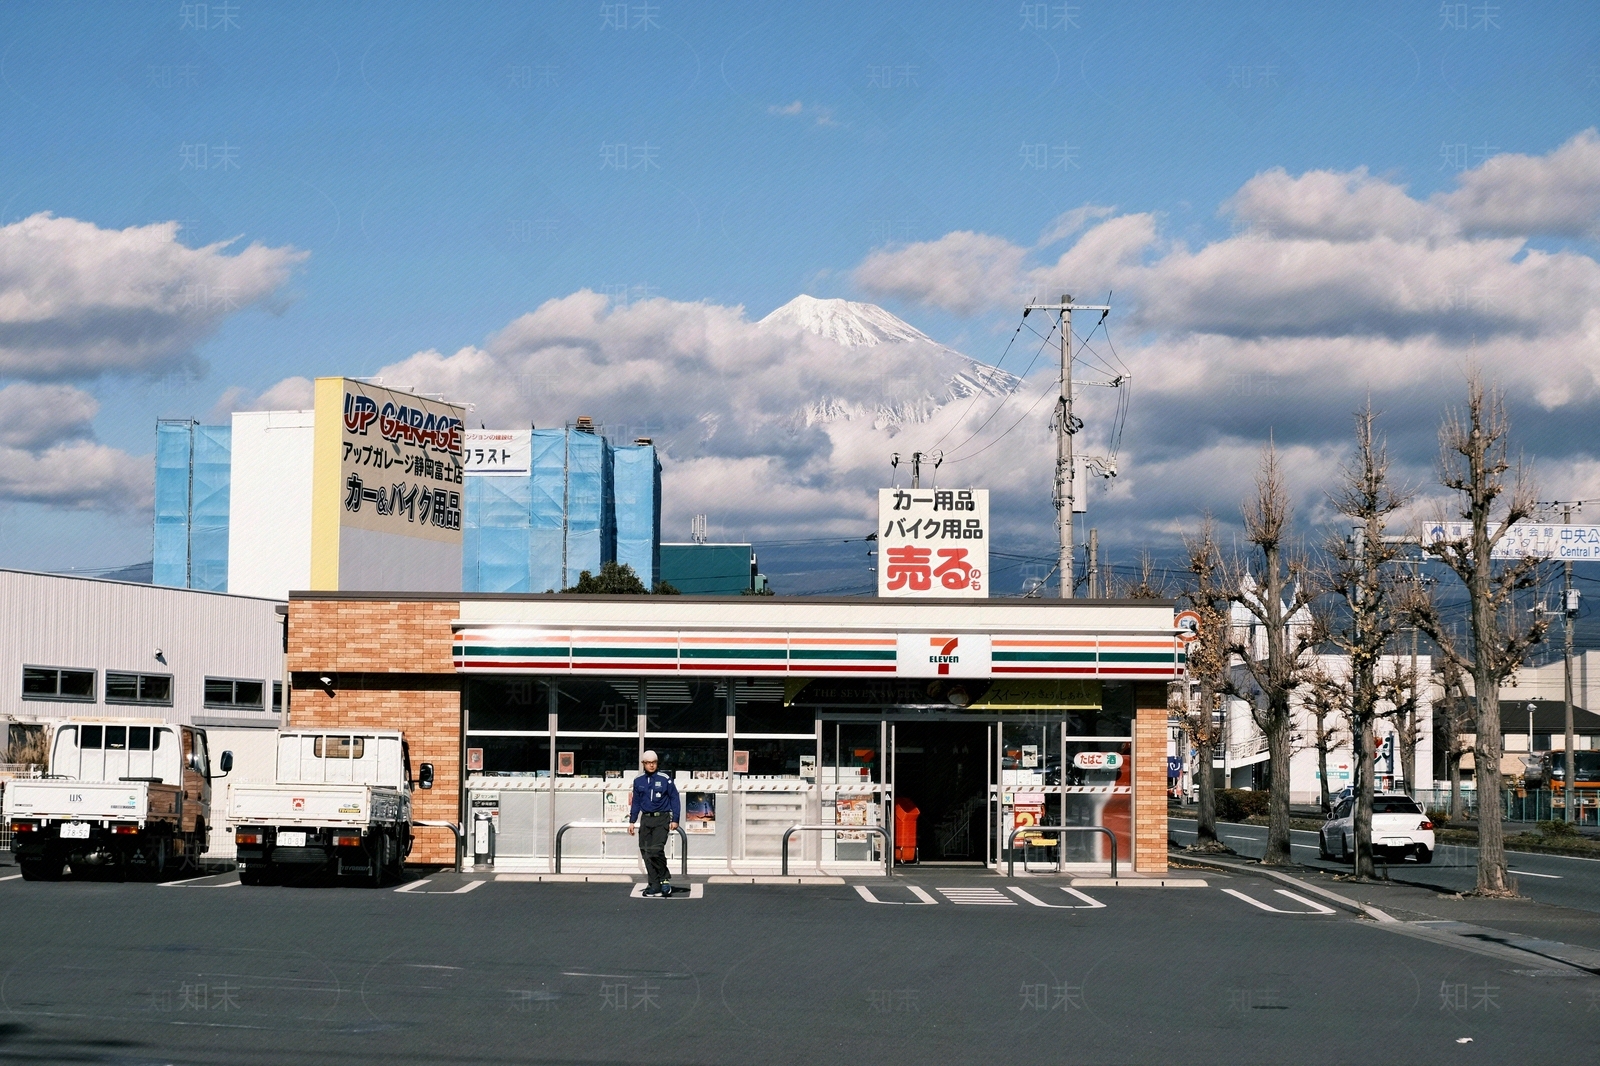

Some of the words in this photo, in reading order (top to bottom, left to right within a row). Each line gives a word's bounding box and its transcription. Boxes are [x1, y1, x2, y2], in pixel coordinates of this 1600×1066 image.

[343, 392, 378, 435] UP
[379, 402, 466, 458] GARAGE
[465, 433, 513, 441] ンションの建設は
[342, 441, 463, 484] アップガレージ静岡富士店
[344, 472, 461, 531] カー&バイク用品
[893, 490, 975, 511] カー用品
[884, 517, 983, 539] バイク用品
[1561, 546, 1591, 557] Central
[813, 688, 836, 697] THE
[840, 689, 878, 698] SEVEN
[879, 690, 924, 699] SWEETS
[1080, 754, 1102, 765] たばこ
[1106, 754, 1116, 765] 酒
